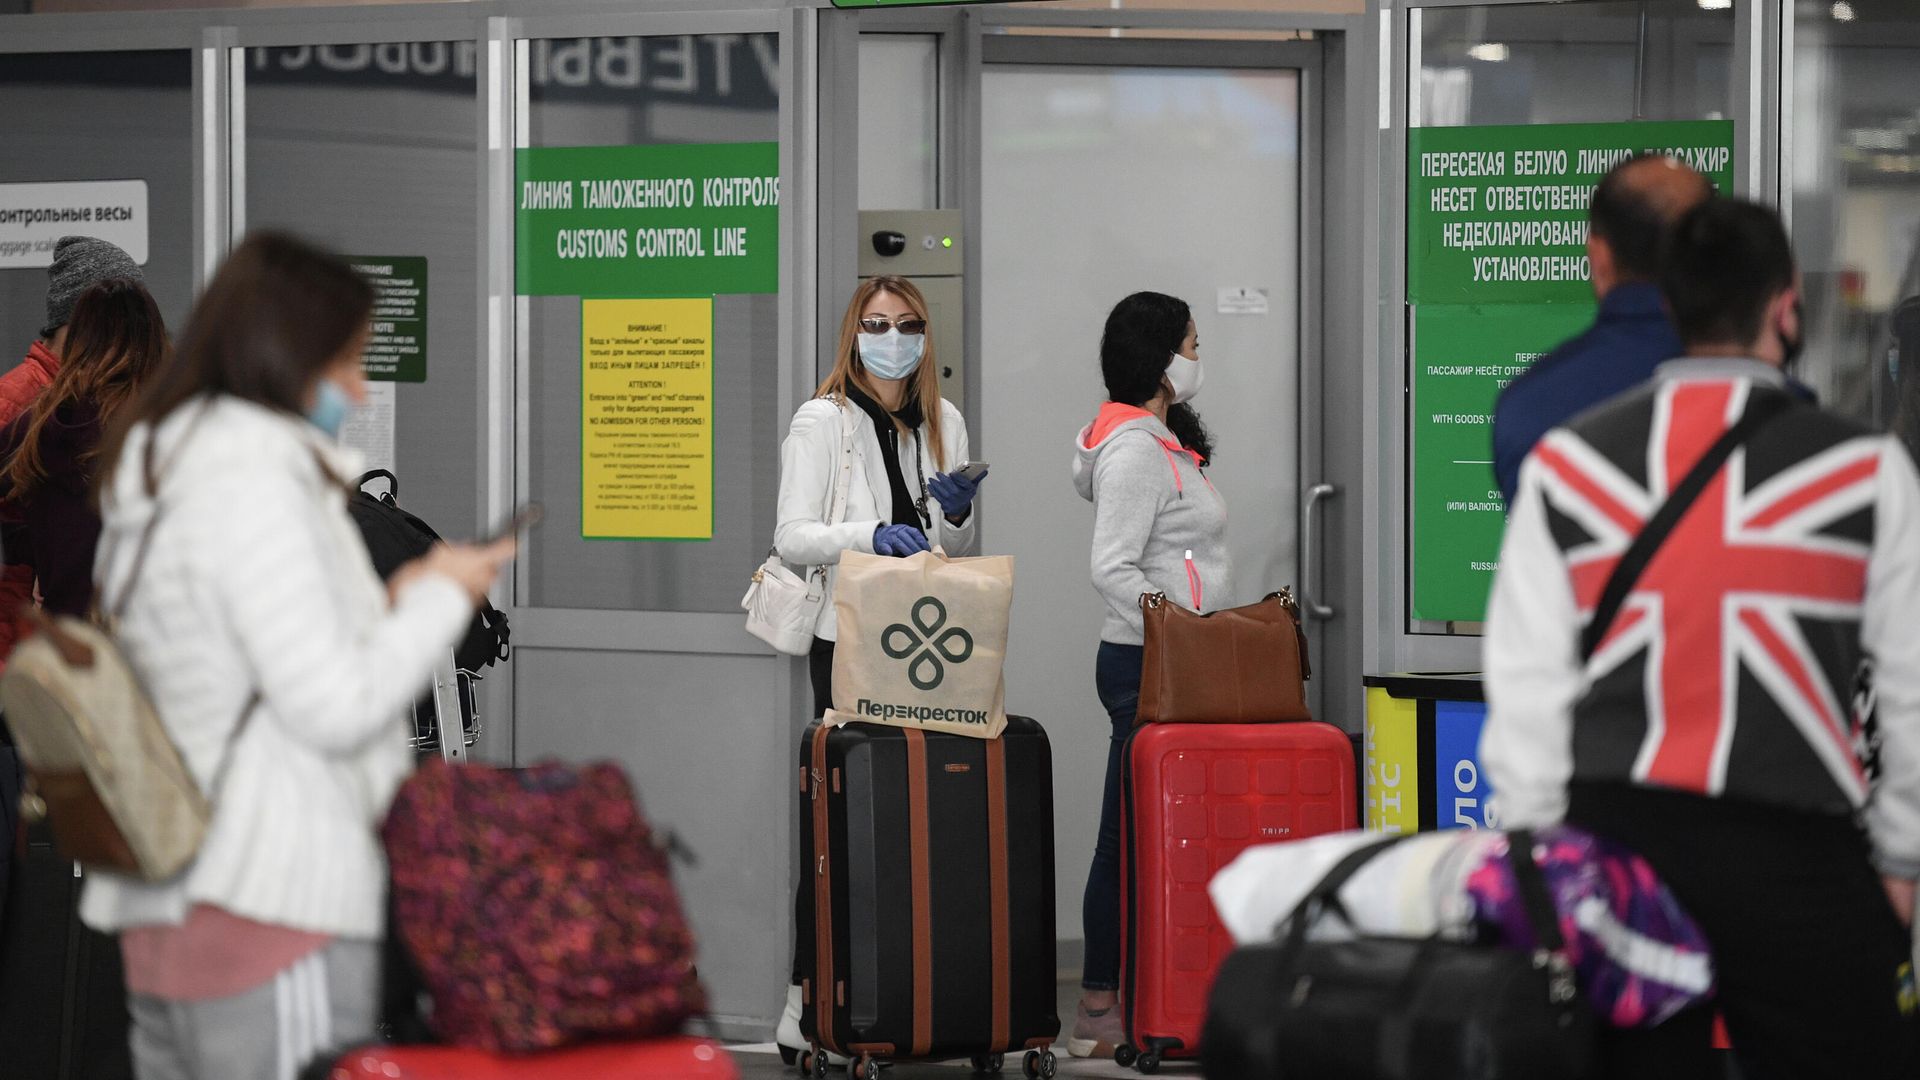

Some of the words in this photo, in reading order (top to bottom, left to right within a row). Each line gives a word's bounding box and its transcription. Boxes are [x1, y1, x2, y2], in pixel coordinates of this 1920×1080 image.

[1422, 151, 1505, 176] ПЕРЕСЕКАЯ
[1514, 150, 1568, 176] БЕЛУЮ
[522, 180, 572, 209] ЛИНИЯ
[581, 178, 694, 209] ТАМОЖЕННОГО
[1432, 186, 1477, 212] НЕСЕТ
[96, 206, 132, 221] весы
[557, 228, 628, 258] CUSTOMS
[636, 228, 705, 258] CONTROL
[714, 227, 746, 257] LINE
[1428, 366, 1473, 375] ПАССАЖИР
[1476, 365, 1502, 376] НЕСЁТ
[1433, 414, 1453, 424] WITH
[1455, 414, 1484, 424] GOODS
[1447, 502, 1467, 512] (ИЛИ)
[1468, 502, 1502, 512] ВАЛЮТЫ
